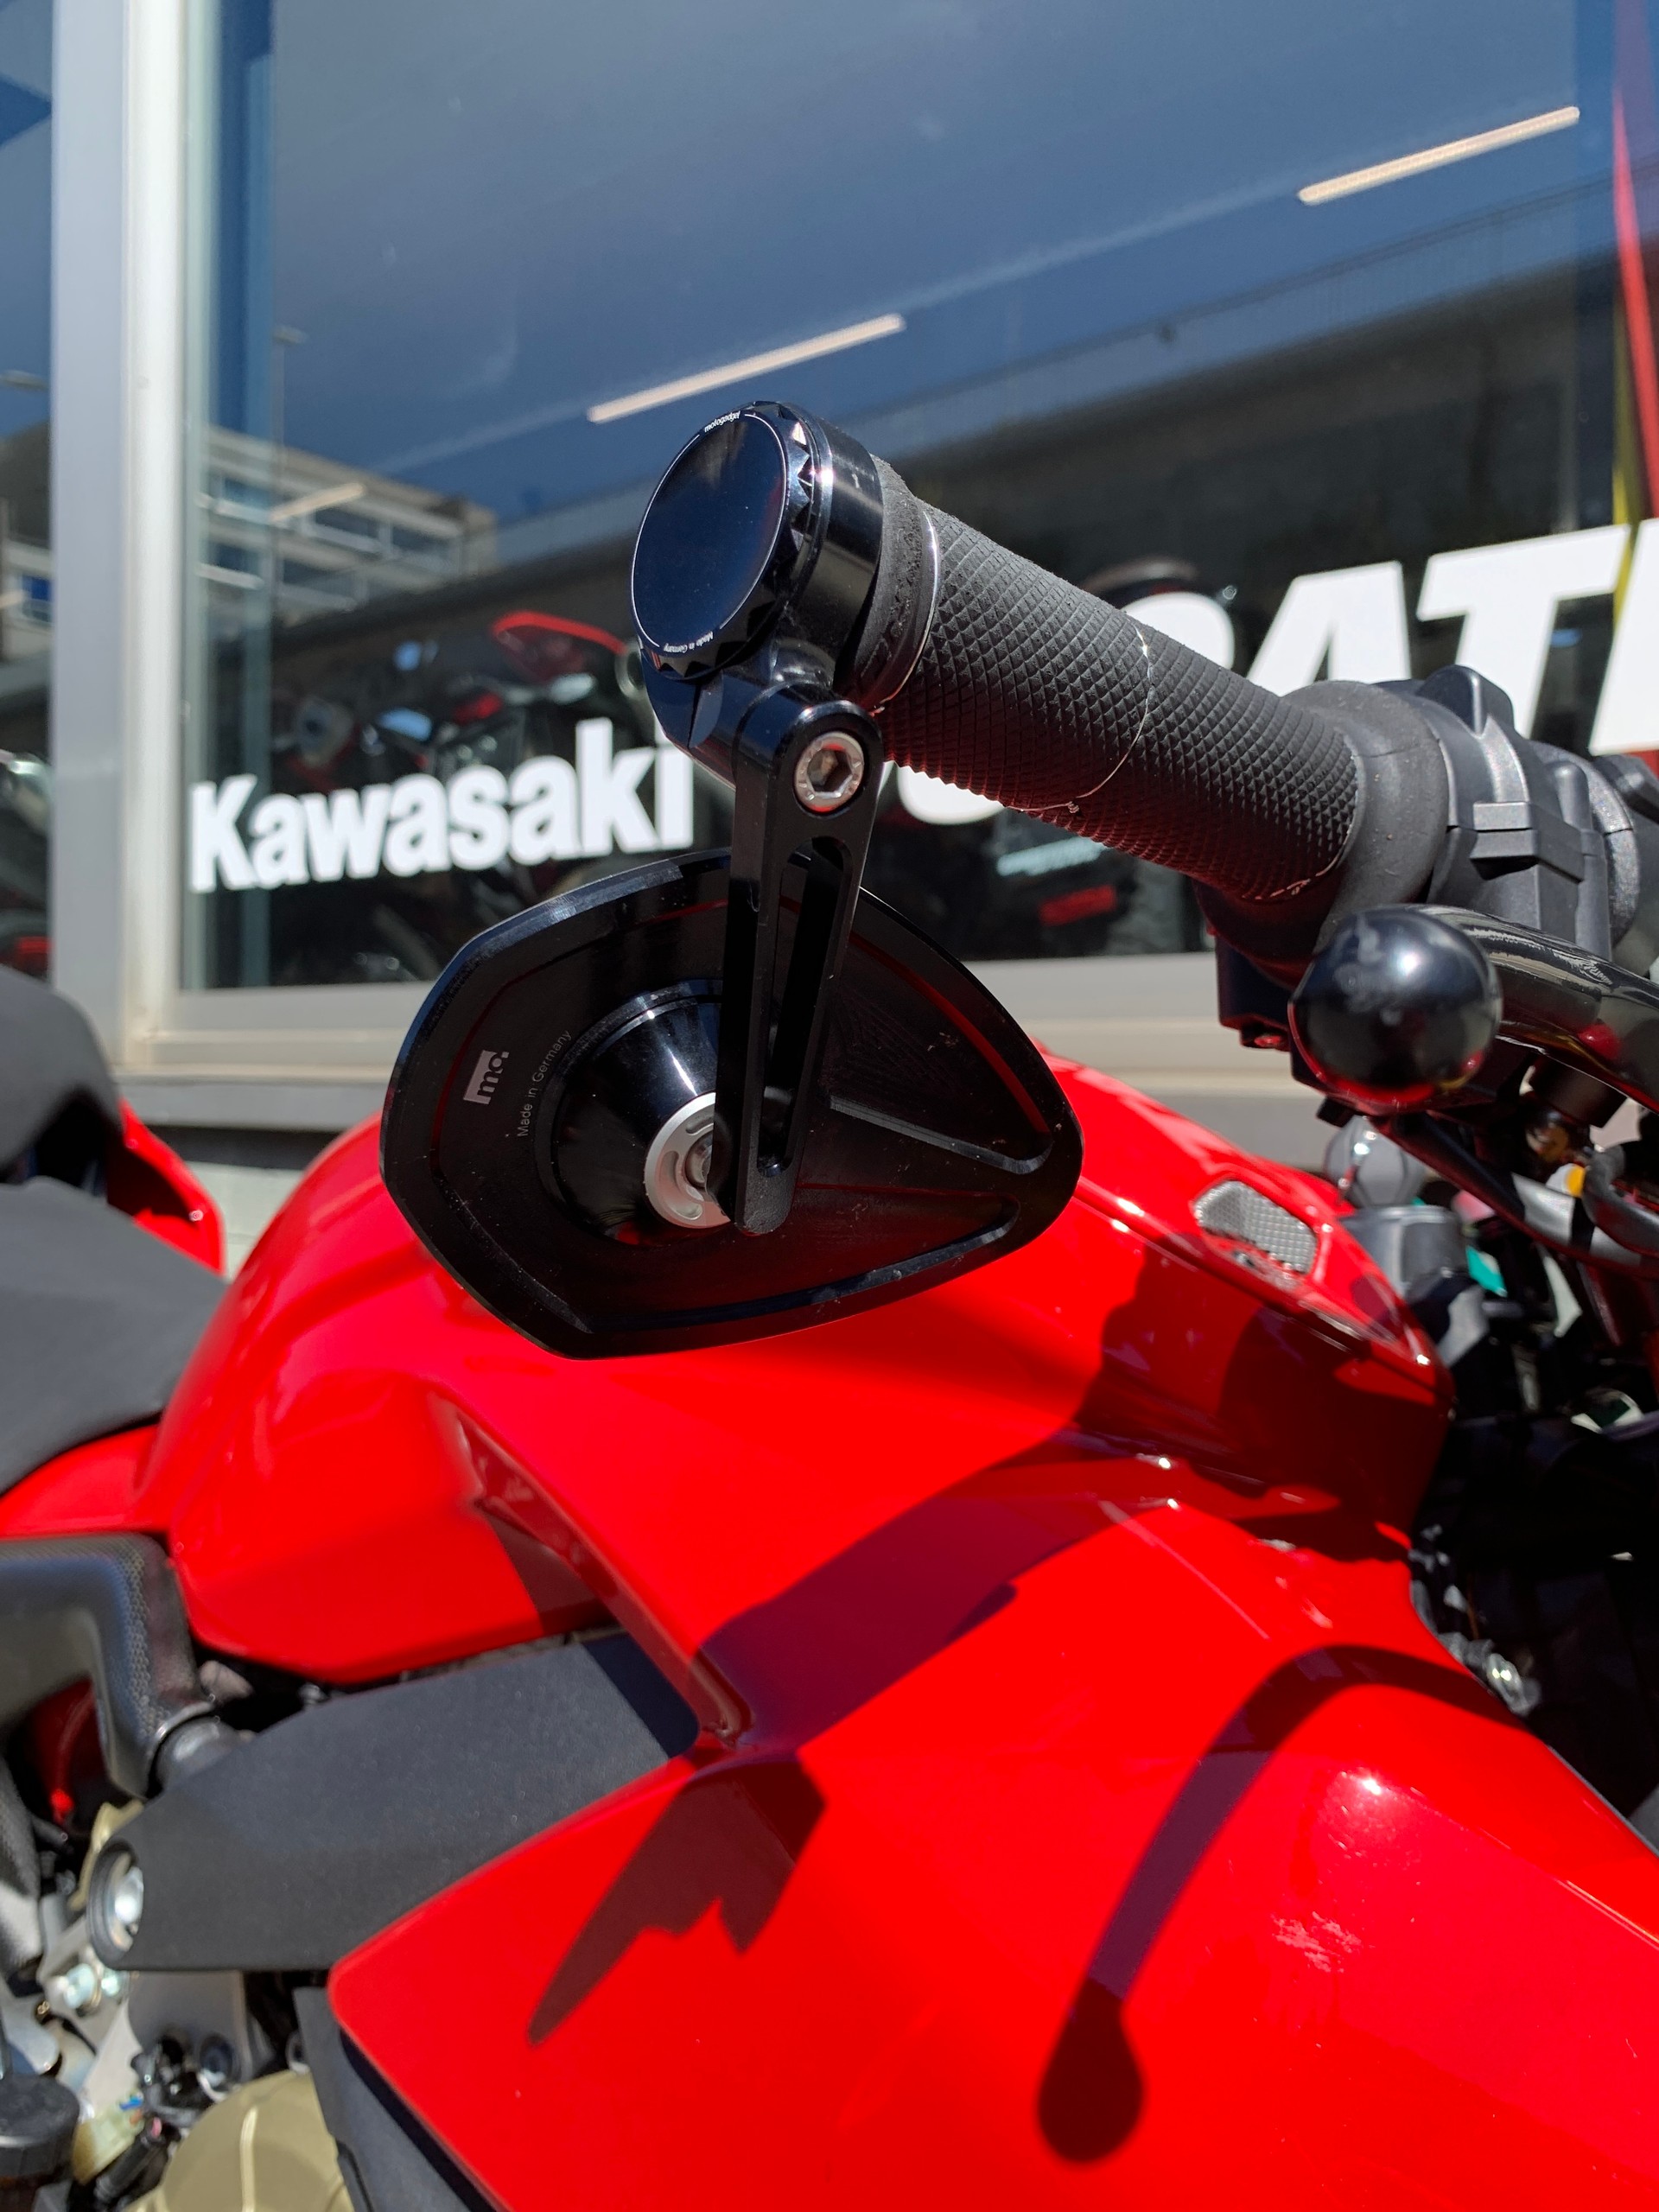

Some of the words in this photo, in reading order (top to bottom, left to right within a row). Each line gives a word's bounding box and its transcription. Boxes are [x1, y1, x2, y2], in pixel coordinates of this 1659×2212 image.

[696, 631, 713, 646] Made
[190, 710, 693, 893] Kawasaki
[531, 1030, 572, 1083] Germany
[527, 1086, 538, 1098] in
[517, 1103, 533, 1137] Made
